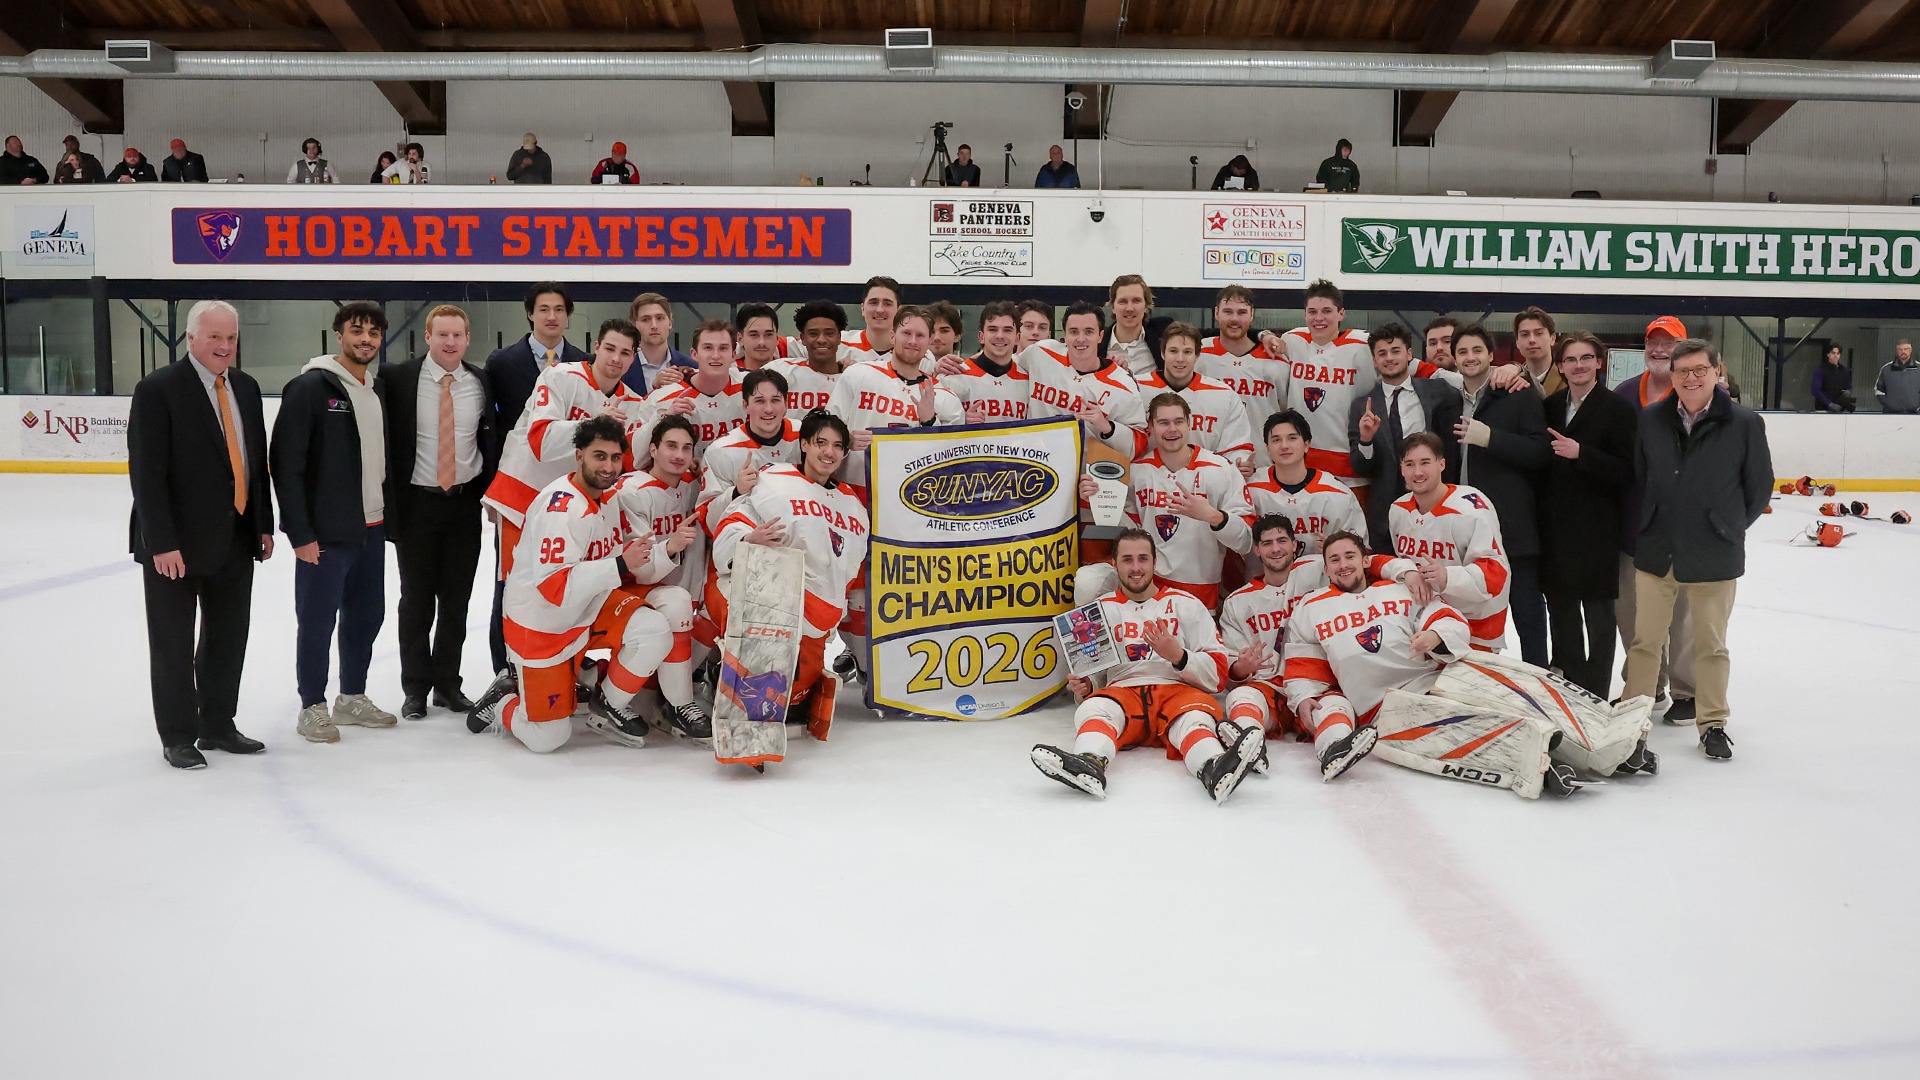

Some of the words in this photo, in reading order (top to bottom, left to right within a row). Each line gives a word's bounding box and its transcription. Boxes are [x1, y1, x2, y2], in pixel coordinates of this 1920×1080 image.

[960, 214, 1031, 226] PANTHERS
[969, 203, 1021, 214] GENEVA
[1232, 207, 1286, 218] GENEVA
[960, 227, 992, 235] SCHOOL
[1232, 219, 1303, 230] GENERALS
[1262, 230, 1294, 238] HOCKEY
[23, 240, 86, 256] GENEVA
[264, 215, 480, 257] HOBART
[502, 215, 826, 258] STATESMEN
[934, 243, 969, 267] Lake
[972, 246, 1016, 262] Country
[1208, 251, 1299, 266] SUCCESS
[1407, 226, 1612, 271] WILLIAM
[1625, 231, 1781, 274] SMITH
[1790, 234, 1920, 278] HERO
[1289, 361, 1358, 386] OBART
[536, 385, 549, 407] 3
[1031, 382, 1095, 413] HOBA
[1098, 390, 1111, 406] C
[1223, 378, 1275, 398] BART
[787, 391, 830, 410] HOB
[858, 391, 920, 422] HOBA
[44, 410, 89, 443] LNB
[90, 417, 127, 428] Banking
[905, 455, 932, 474] STATE
[934, 444, 980, 462] UNIVERSITY
[983, 444, 994, 454] OF
[997, 445, 1019, 456] NEW
[1022, 447, 1050, 462] YORK
[912, 467, 1046, 507] SUNYAC
[926, 519, 971, 532] ATHLETIC
[973, 509, 1036, 532] CONFERENCE
[539, 537, 565, 565] 92
[881, 551, 951, 585] MEN'S
[957, 553, 992, 581] ICE
[997, 532, 1074, 578] HOCKEY
[1396, 535, 1456, 561] OBART
[877, 573, 1075, 623] CHAMPIONS
[1164, 598, 1174, 614] A
[1315, 600, 1412, 641] HOBART
[746, 626, 792, 639] CCM
[906, 626, 1057, 694] 2026
[1546, 672, 1602, 705] CCM
[1441, 764, 1502, 784] CCM
